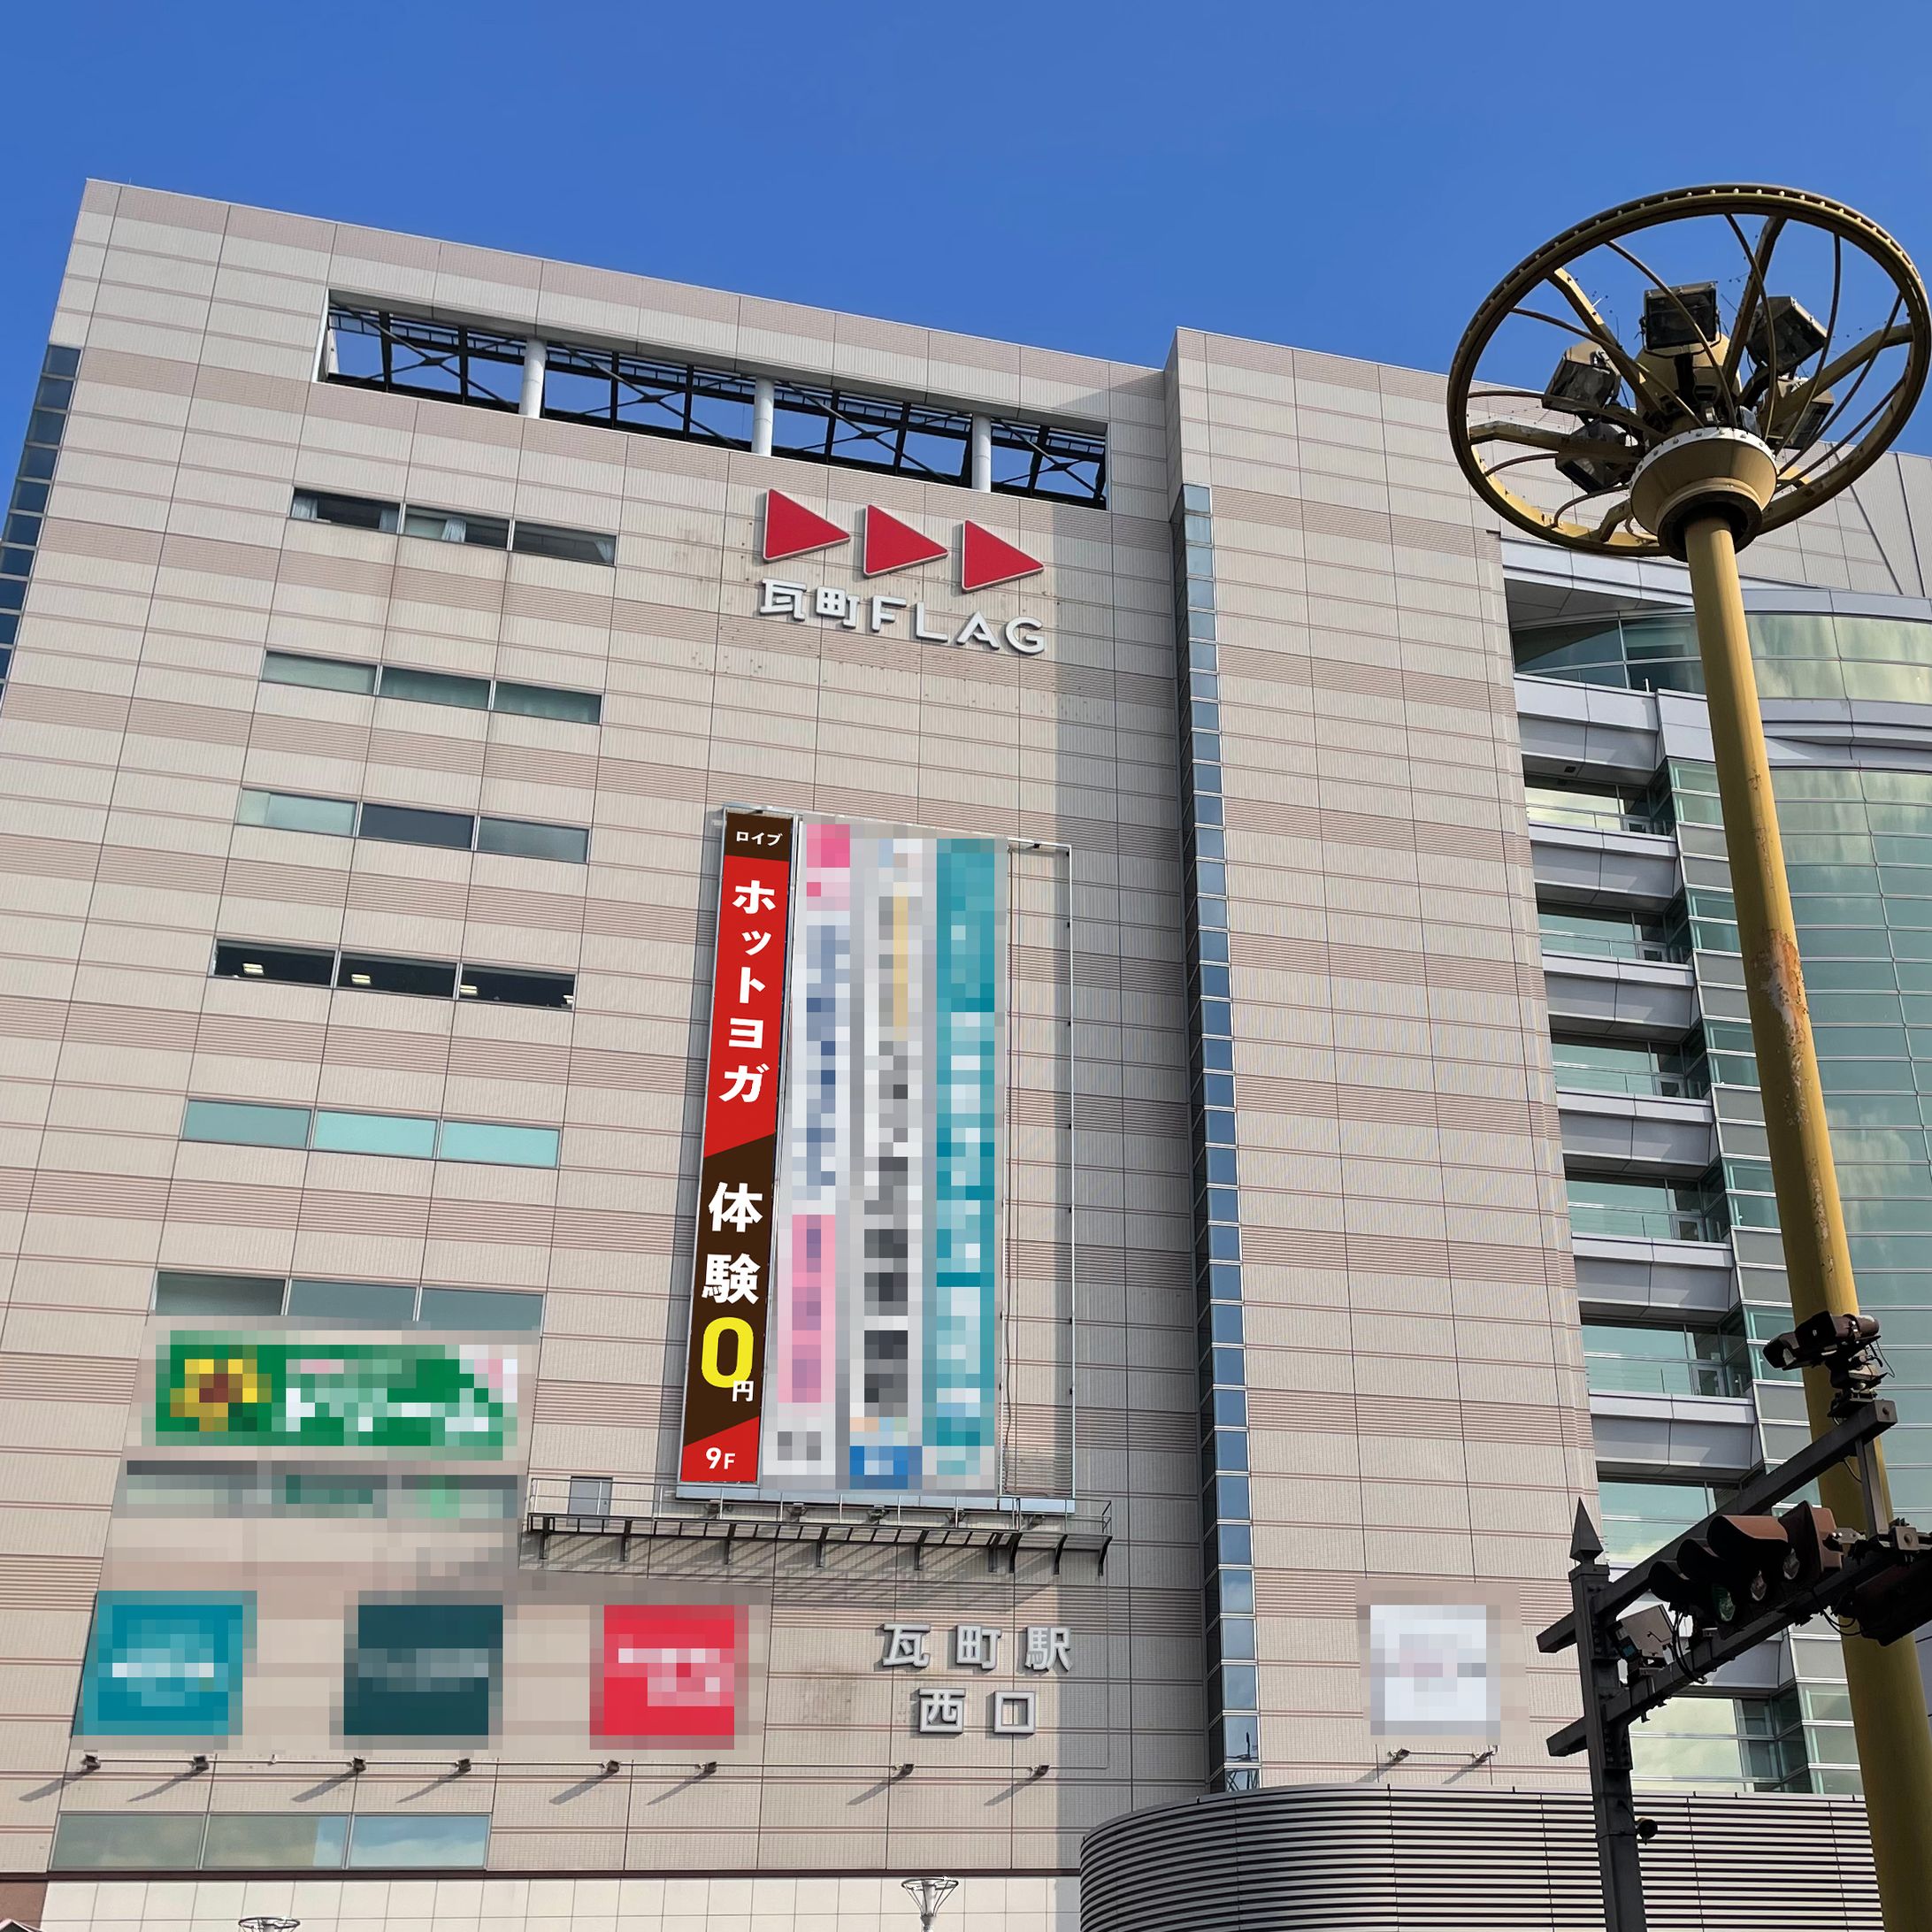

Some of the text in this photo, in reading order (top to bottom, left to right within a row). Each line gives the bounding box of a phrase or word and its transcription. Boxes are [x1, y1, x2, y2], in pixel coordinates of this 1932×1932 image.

[759, 577, 1046, 656] 瓦町FLAG
[735, 831, 783, 847] ロイブ
[719, 879, 776, 1103] ホットヨガ
[705, 1447, 736, 1470] 9F
[882, 1622, 1072, 1672] 瓦町駅
[918, 1688, 1036, 1734] 西口
